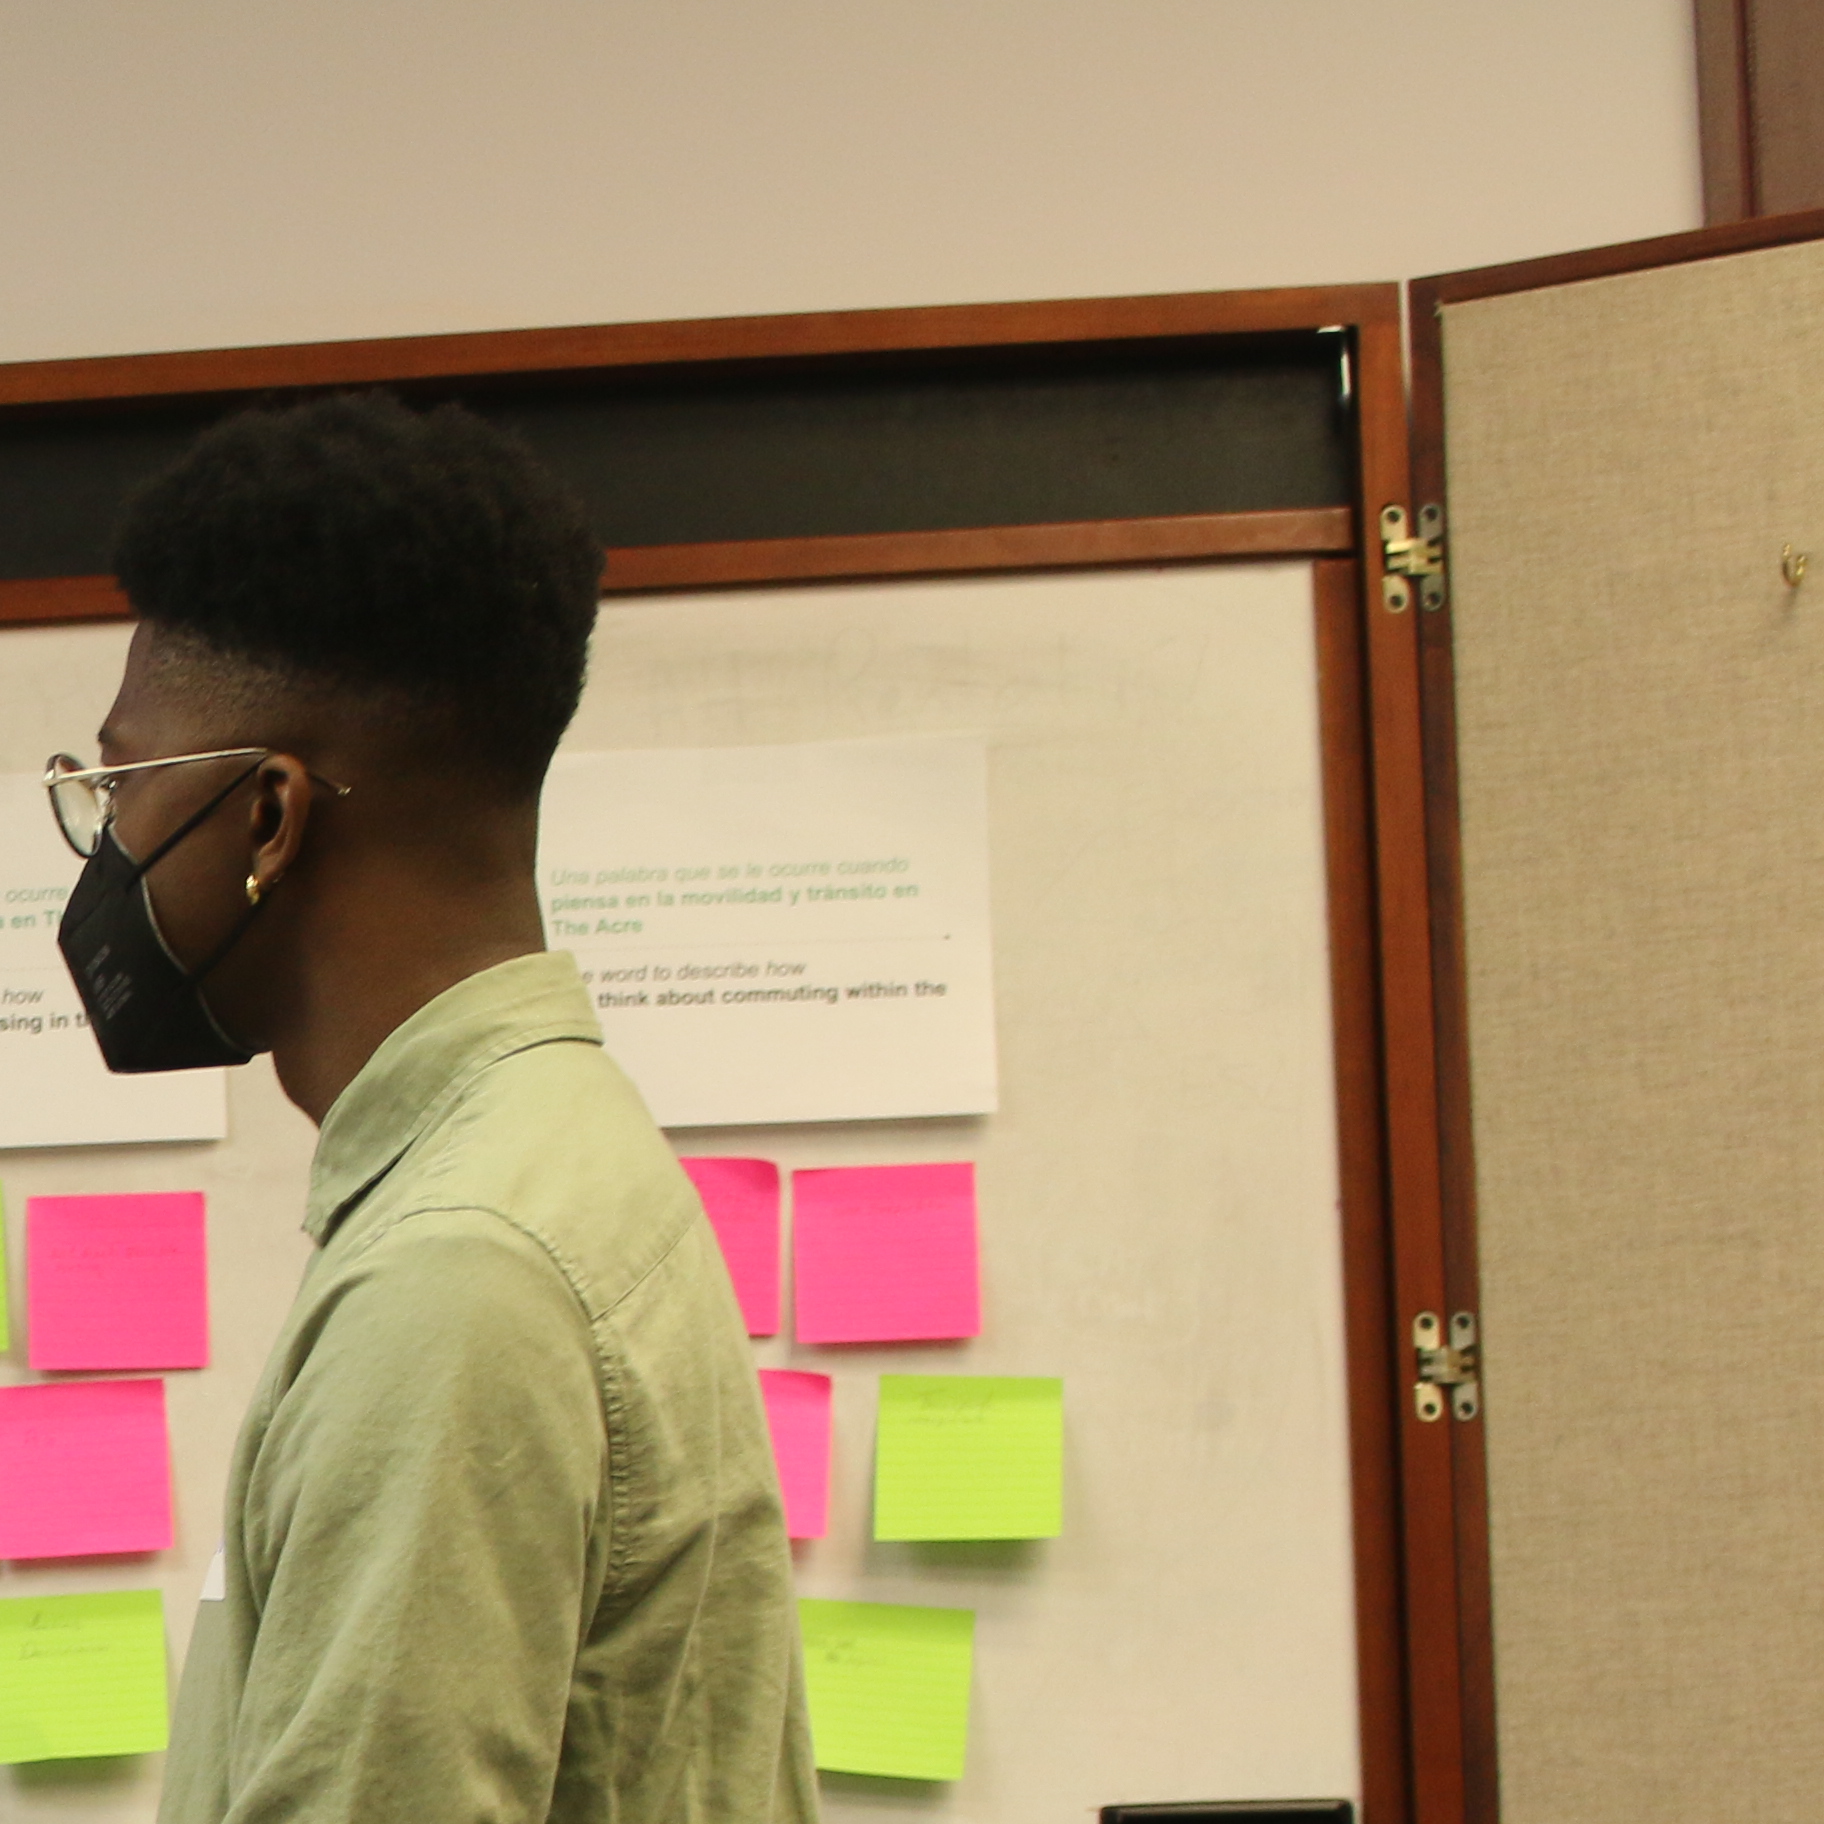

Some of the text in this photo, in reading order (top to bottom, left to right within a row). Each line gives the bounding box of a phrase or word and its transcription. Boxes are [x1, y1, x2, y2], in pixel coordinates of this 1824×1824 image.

[549, 855, 909, 887] Una palabra que se le ocurre cuando
[3, 886, 69, 901] ocurre
[549, 895, 620, 913] piensa
[624, 894, 650, 907] en
[655, 889, 675, 906] la
[787, 889, 801, 905] y
[892, 885, 918, 898] en
[9, 915, 36, 928] en
[550, 917, 642, 936] The Acre
[599, 965, 648, 982] word
[651, 964, 672, 980] to
[675, 961, 760, 980] describe
[764, 959, 805, 976] how
[1, 986, 42, 1004] how
[596, 980, 947, 1006] think about commuting within the
[48, 1017, 69, 1029] in
